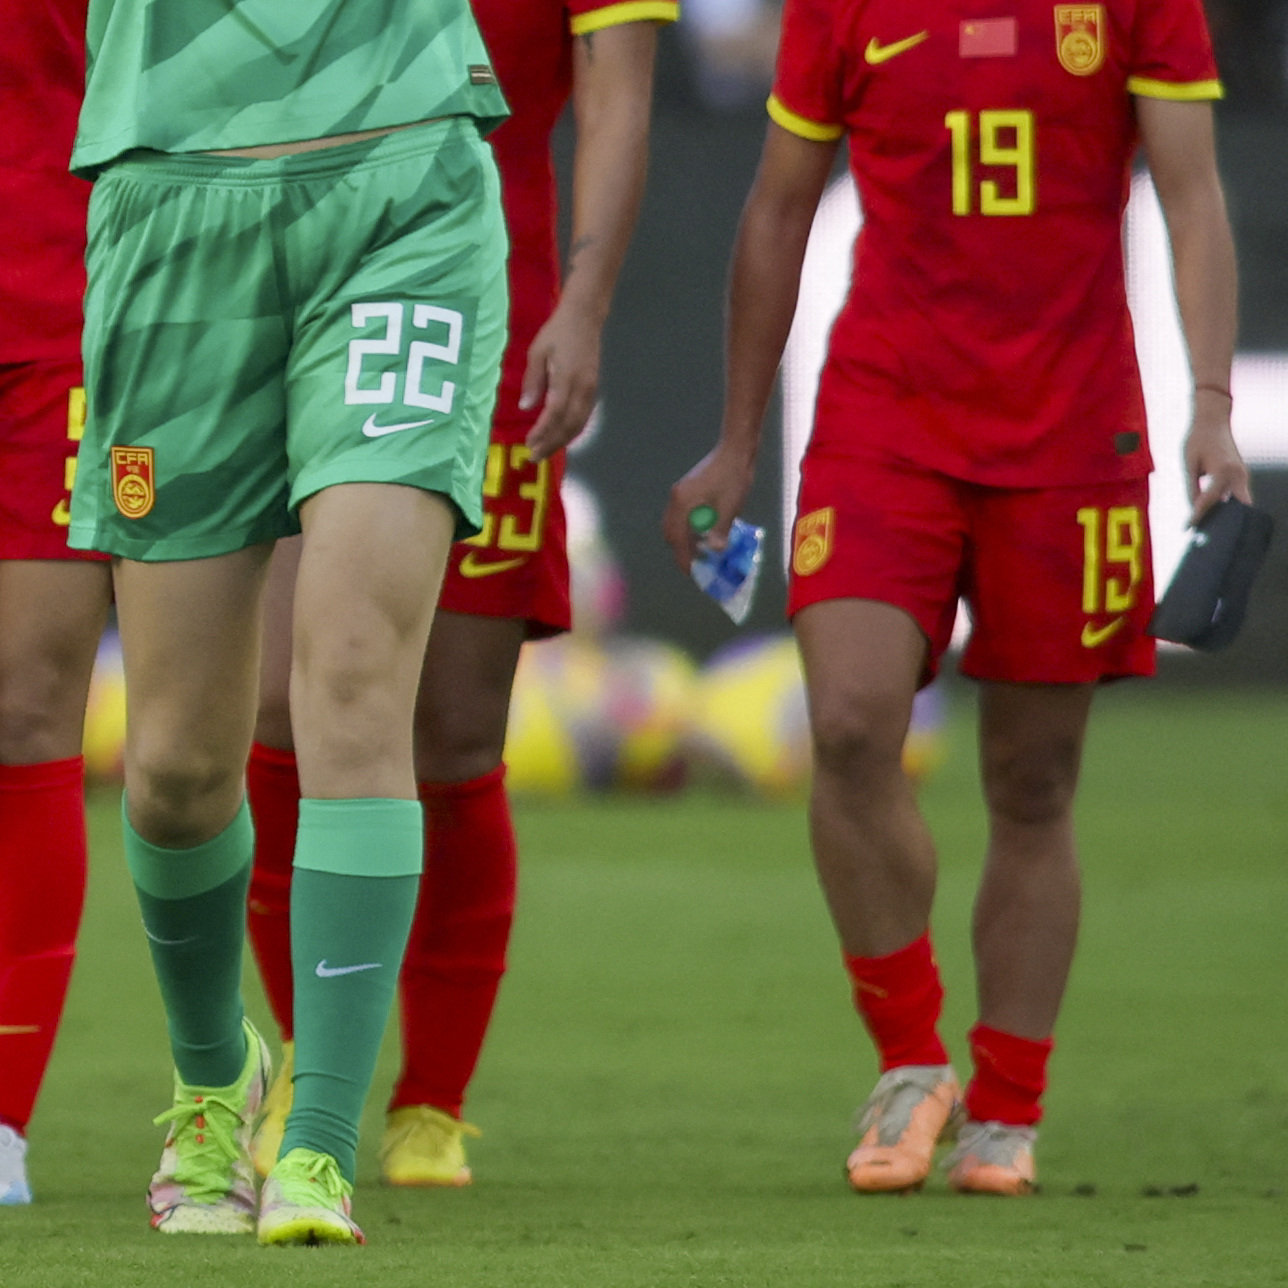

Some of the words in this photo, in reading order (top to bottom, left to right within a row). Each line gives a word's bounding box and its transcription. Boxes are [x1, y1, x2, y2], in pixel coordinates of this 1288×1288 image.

[943, 109, 1035, 217] 19
[344, 302, 463, 414] 22
[116, 452, 149, 466] CFA
[1077, 506, 1142, 613] 19
